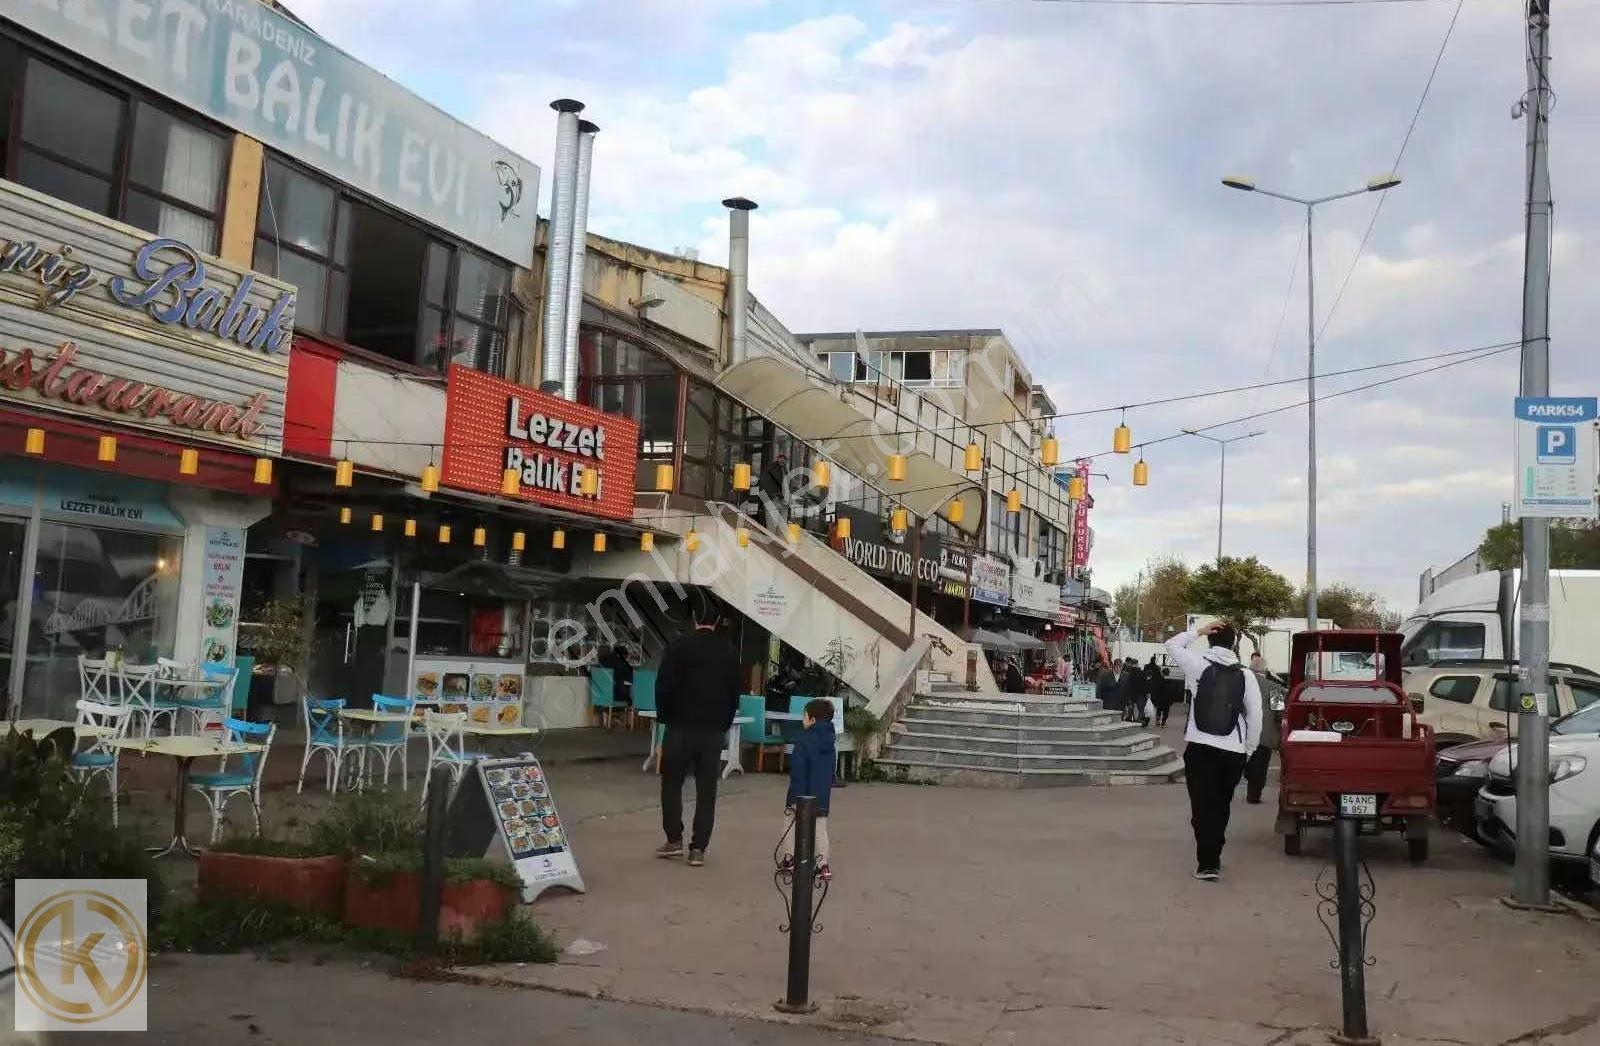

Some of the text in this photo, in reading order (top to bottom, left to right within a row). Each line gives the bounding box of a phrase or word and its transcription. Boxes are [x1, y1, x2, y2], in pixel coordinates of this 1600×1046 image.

[224, 31, 387, 188] BALIK
[0, 341, 266, 439] staurant
[509, 397, 606, 461] Lezzet
[1547, 430, 1566, 454] P
[570, 462, 604, 501] Ei
[60, 500, 97, 514] LEZZET
[98, 503, 126, 518] BALIK
[844, 538, 939, 582] WORLD TOBCCO
